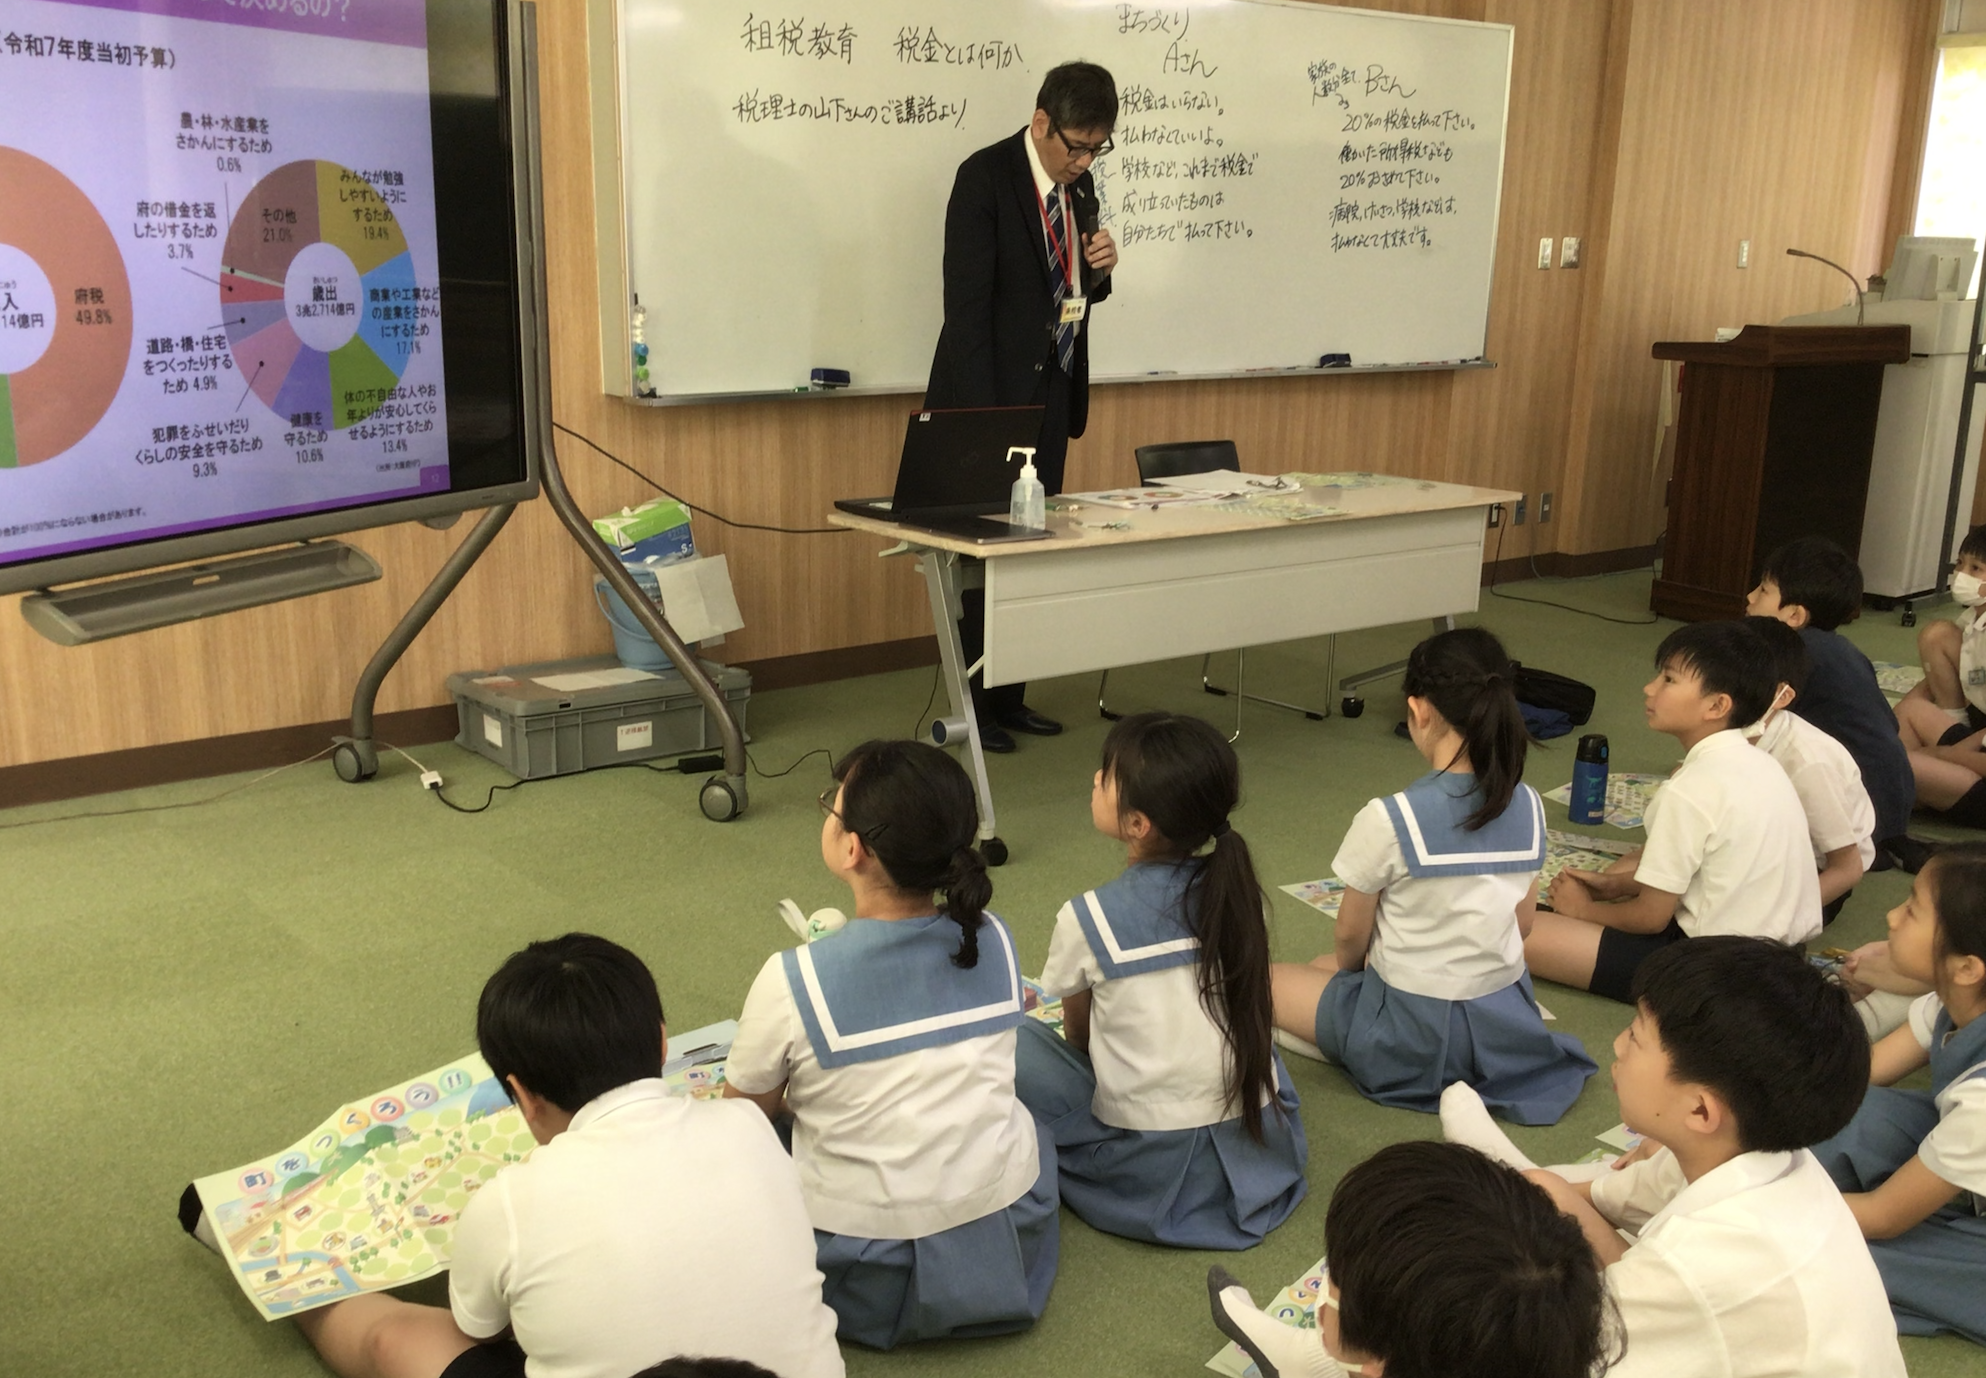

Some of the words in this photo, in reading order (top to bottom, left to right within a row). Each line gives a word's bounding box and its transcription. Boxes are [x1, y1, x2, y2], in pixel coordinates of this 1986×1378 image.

[740, 13, 858, 65] 租税教育
[0, 31, 176, 70] 令和7年度当初予算)
[1163, 41, 1218, 78] Aさん
[1365, 64, 1417, 98] Bさん
[1120, 84, 1224, 116] 税金はいらない。
[180, 112, 269, 134] 農・林・水産業を
[176, 133, 273, 154] さかんにするため
[1121, 125, 1224, 147] 払わなくていいよ。
[216, 156, 242, 173] 0.6%
[340, 169, 404, 186] みんなが勉強
[340, 188, 407, 203] しやすいように
[136, 200, 217, 219] 府の借金を返
[262, 208, 298, 224] その他
[353, 207, 393, 222] するため
[133, 222, 218, 239] したりするため
[263, 227, 294, 243] 21.0%
[364, 226, 389, 241] 19.4%
[168, 243, 194, 259] 3.7%
[74, 287, 105, 305] 府税
[312, 285, 338, 302] 歳出
[370, 287, 440, 302] 商業や工業など
[75, 308, 113, 325] 49.8%
[371, 305, 440, 321] の産業をさかん
[380, 322, 430, 338] にするため
[146, 334, 228, 355] 道路・橋・住宅
[396, 341, 421, 355] 17.1%
[143, 353, 233, 375] をつくったりする
[163, 377, 189, 394] ため
[193, 375, 218, 392] 4.9%
[344, 384, 437, 404] 体の不自由な人やお
[346, 400, 437, 422] 年よりが安心してくら
[290, 411, 323, 429] 健康を
[152, 418, 249, 444] 犯罪をふせいだり
[348, 419, 434, 440] せるようにするため
[284, 430, 328, 447] 守るため
[382, 440, 408, 454] 13.4%
[135, 436, 263, 465] くらしの安全を守るため
[296, 448, 324, 464] 10.6%
[193, 461, 218, 478] 9.3%
